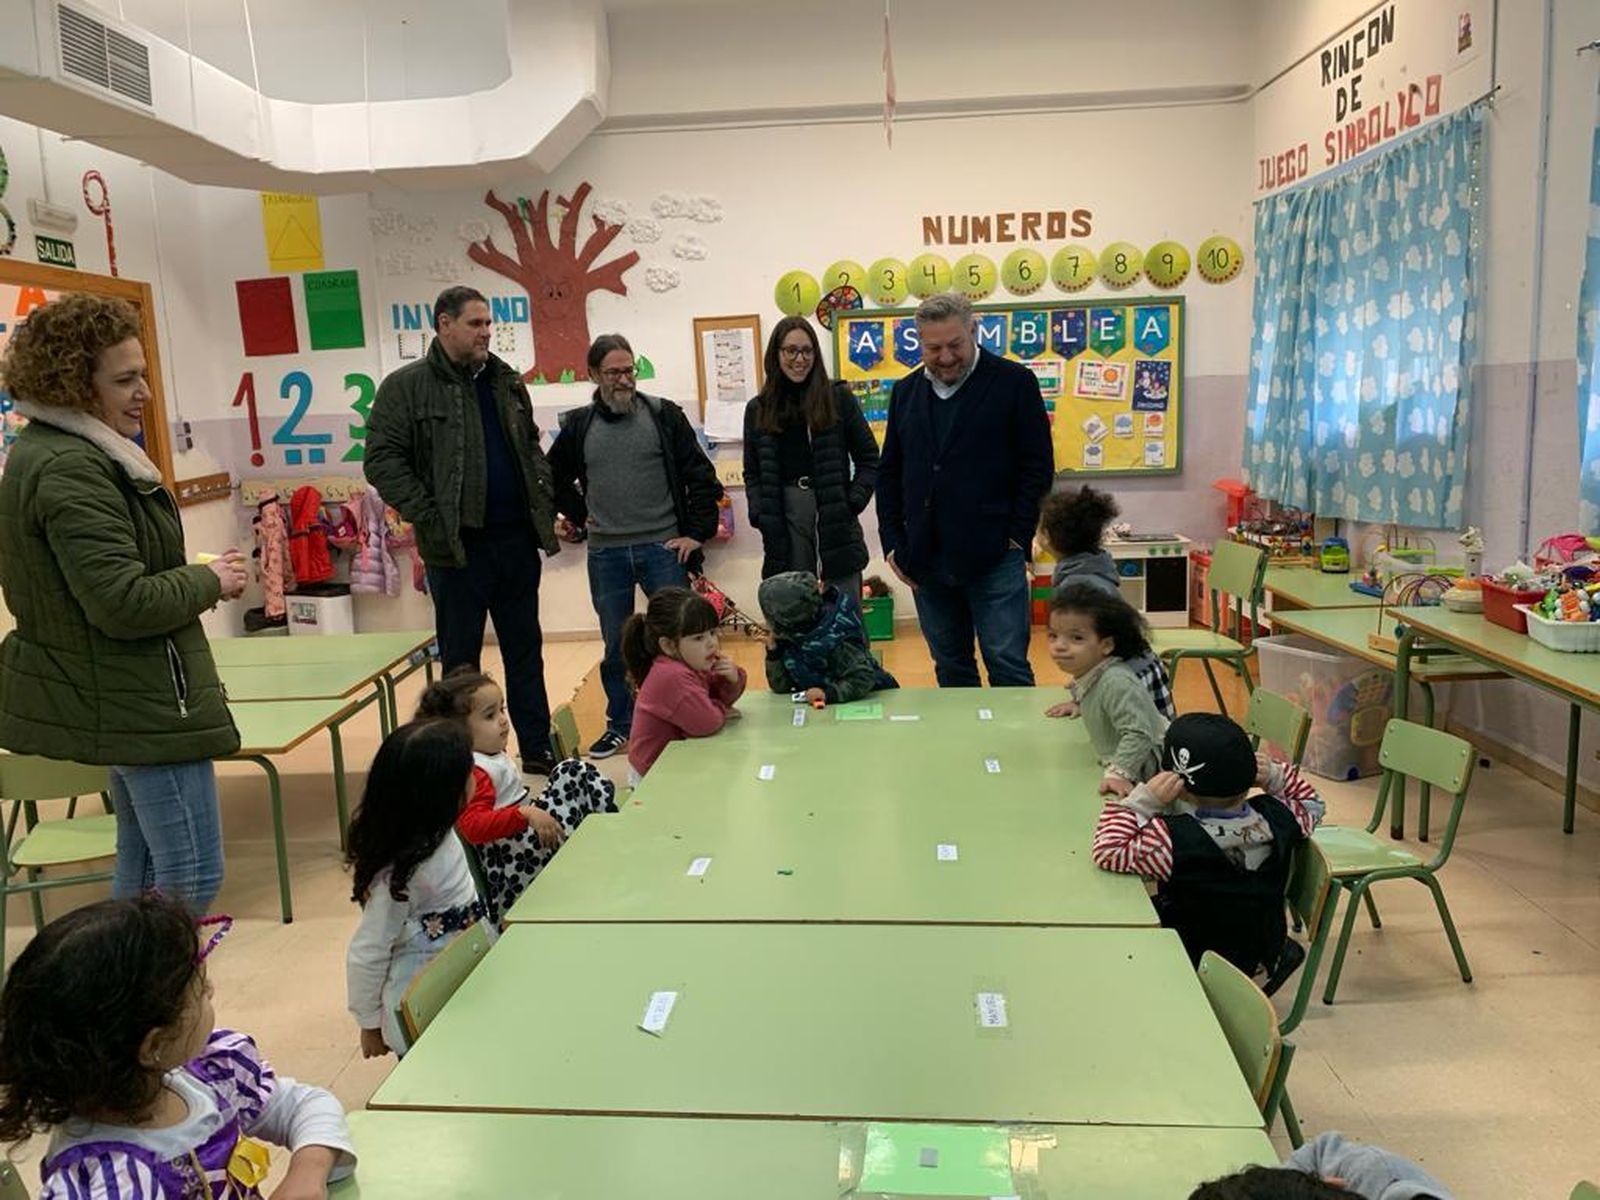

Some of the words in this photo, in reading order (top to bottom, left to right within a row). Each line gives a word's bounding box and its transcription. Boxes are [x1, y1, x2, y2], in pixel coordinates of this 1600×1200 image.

[1320, 5, 1395, 87] RINCON
[1336, 75, 1362, 123] DE
[1259, 143, 1308, 190] JUEGO
[923, 209, 1093, 246] NUMEROS
[36, 239, 75, 265] SALIDA
[792, 282, 801, 303] 1
[882, 270, 895, 290] 3
[923, 264, 937, 284] 4
[969, 265, 981, 286] 5
[1019, 260, 1031, 281] 6
[1067, 256, 1079, 277] 7
[1114, 253, 1127, 274] 8
[1162, 253, 1173, 273] 9
[1208, 247, 1228, 269] 10
[392, 297, 529, 330] INVNO
[856, 315, 1163, 353] ASMBLEA
[272, 371, 333, 445] 2
